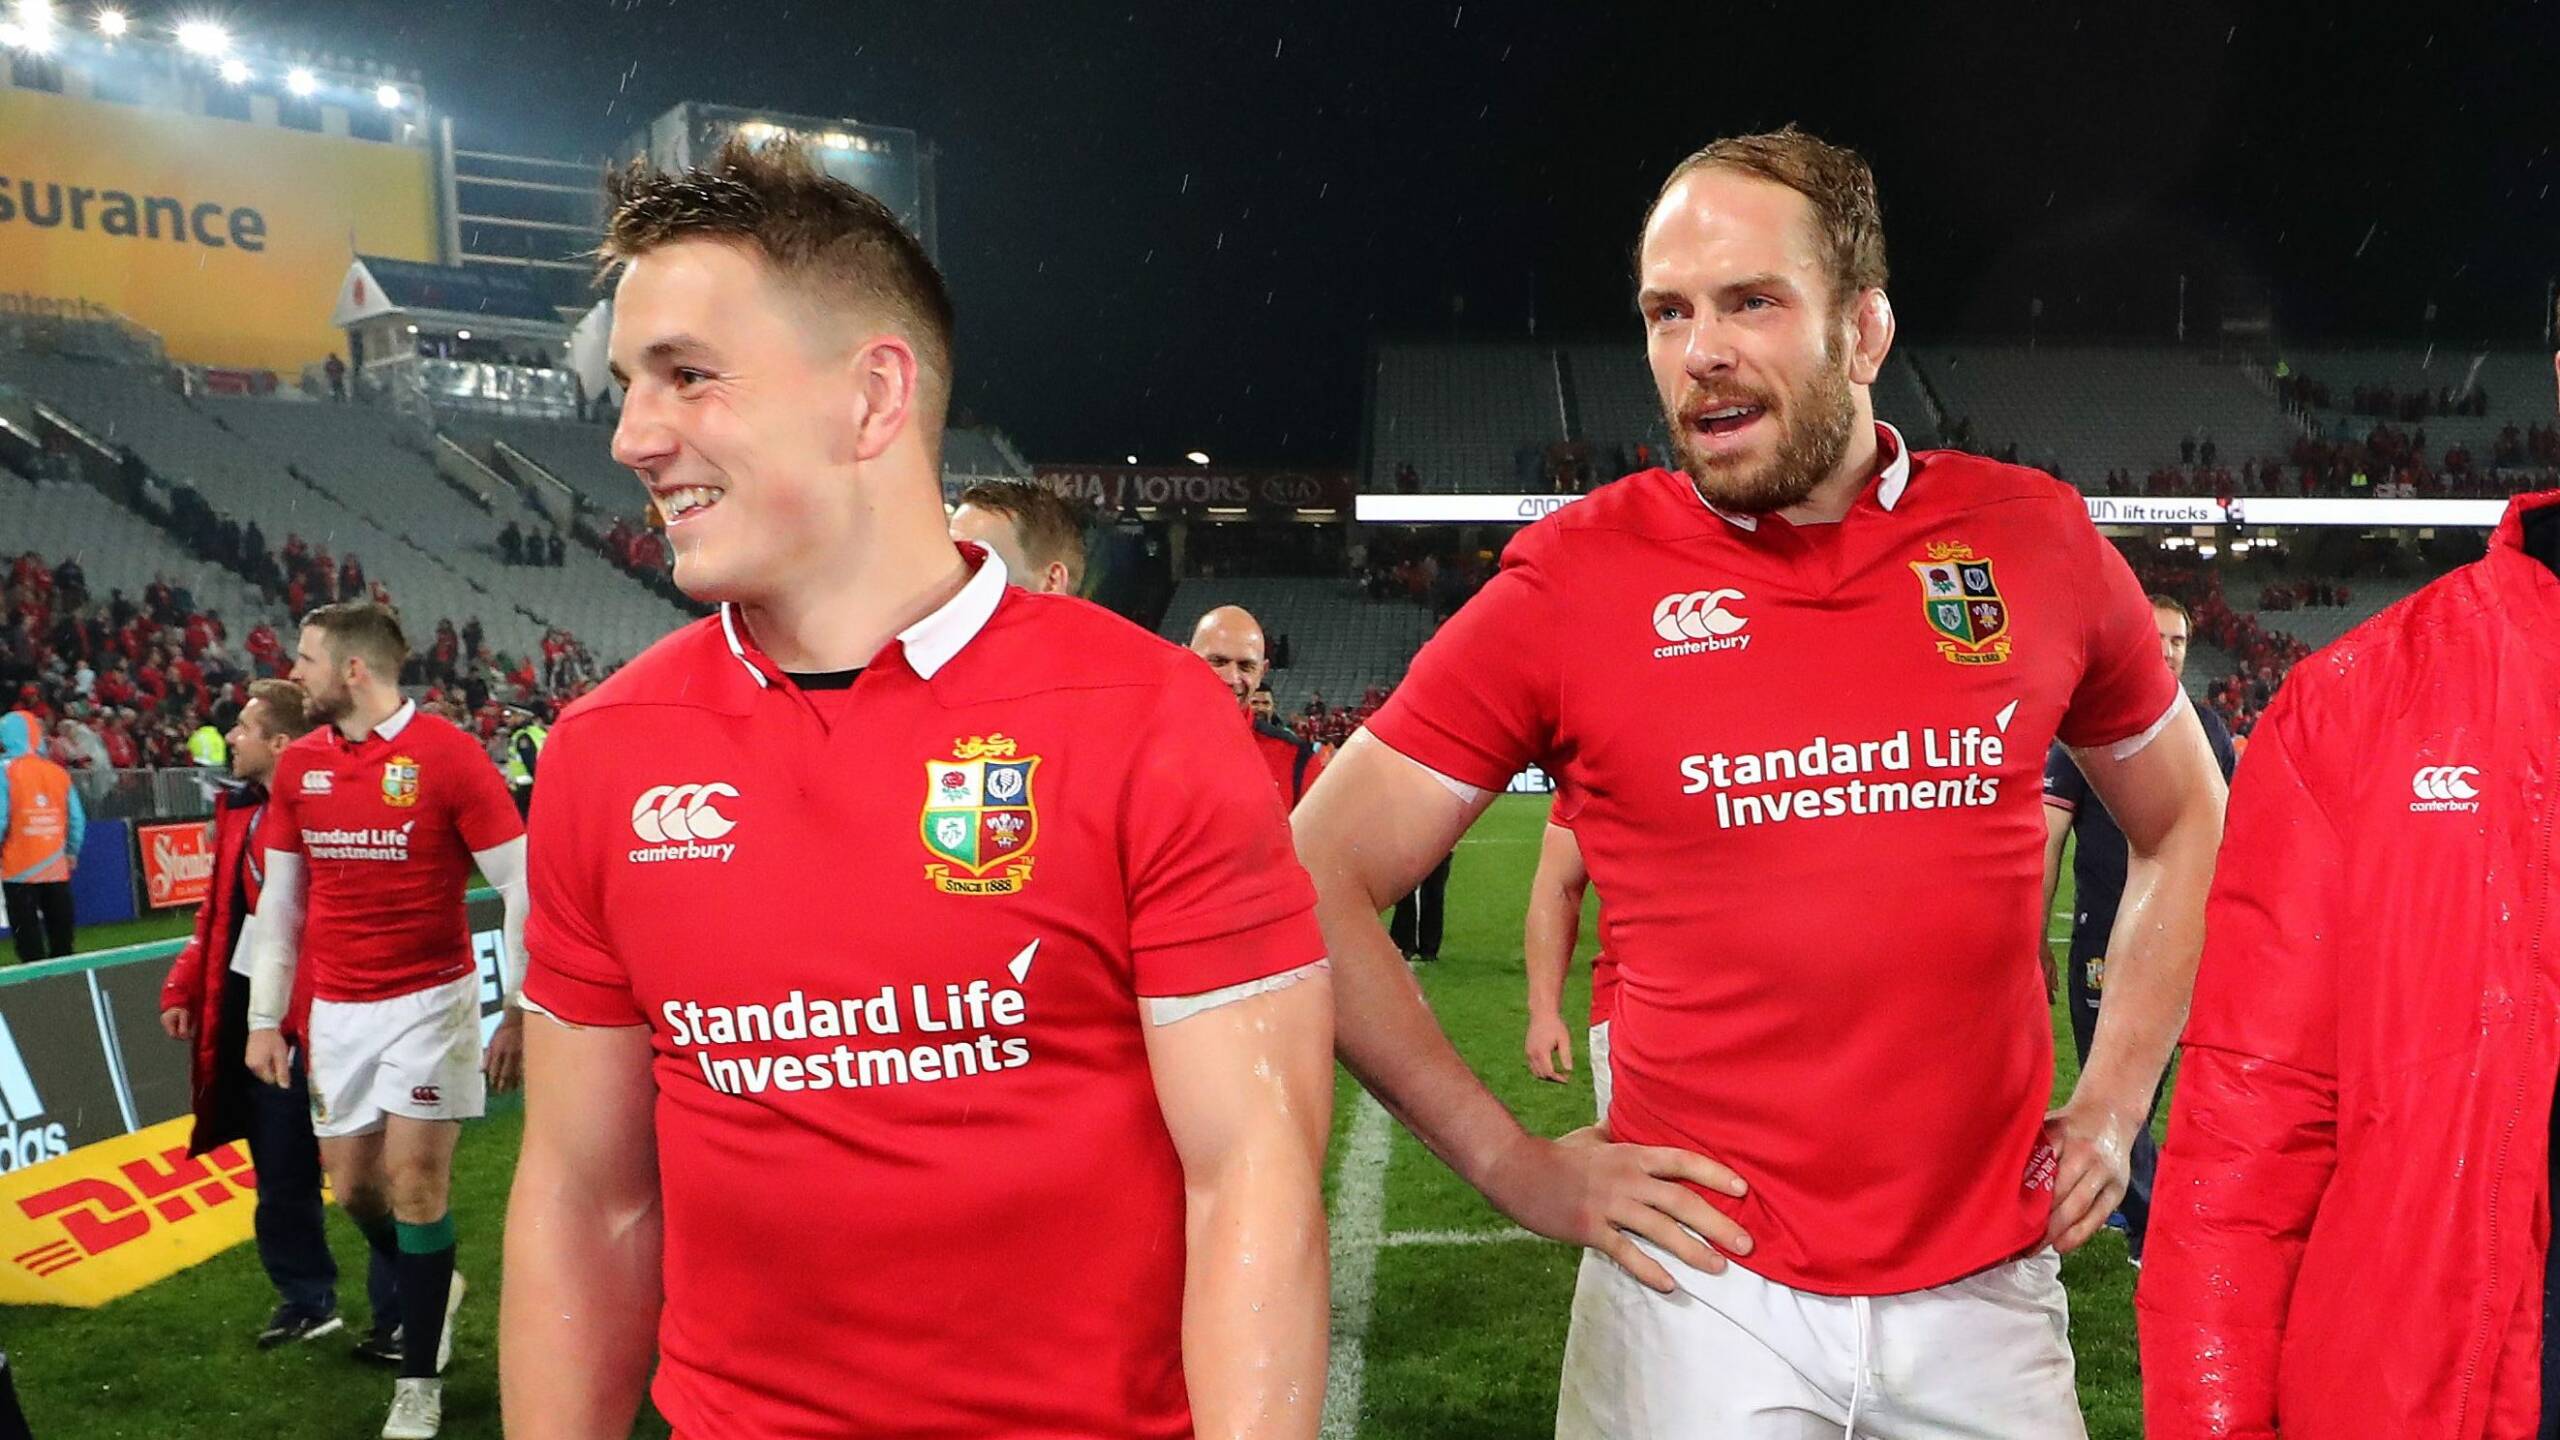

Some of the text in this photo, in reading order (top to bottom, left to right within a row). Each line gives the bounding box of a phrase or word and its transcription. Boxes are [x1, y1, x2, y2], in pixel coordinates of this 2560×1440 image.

[0, 175, 267, 252] surance
[2123, 505, 2145, 520] lift
[2150, 505, 2208, 520] trucks
[1653, 634, 1751, 660] canterbury
[1680, 726, 2003, 795] Standard Life
[1714, 773, 2000, 829] Investments
[2409, 800, 2480, 814] canterbury
[371, 829, 408, 846] Life
[628, 839, 736, 863] canterbury
[661, 979, 1026, 1047] Standard Life
[697, 1033, 1031, 1095] Investments
[16, 1142, 257, 1256] DHL
